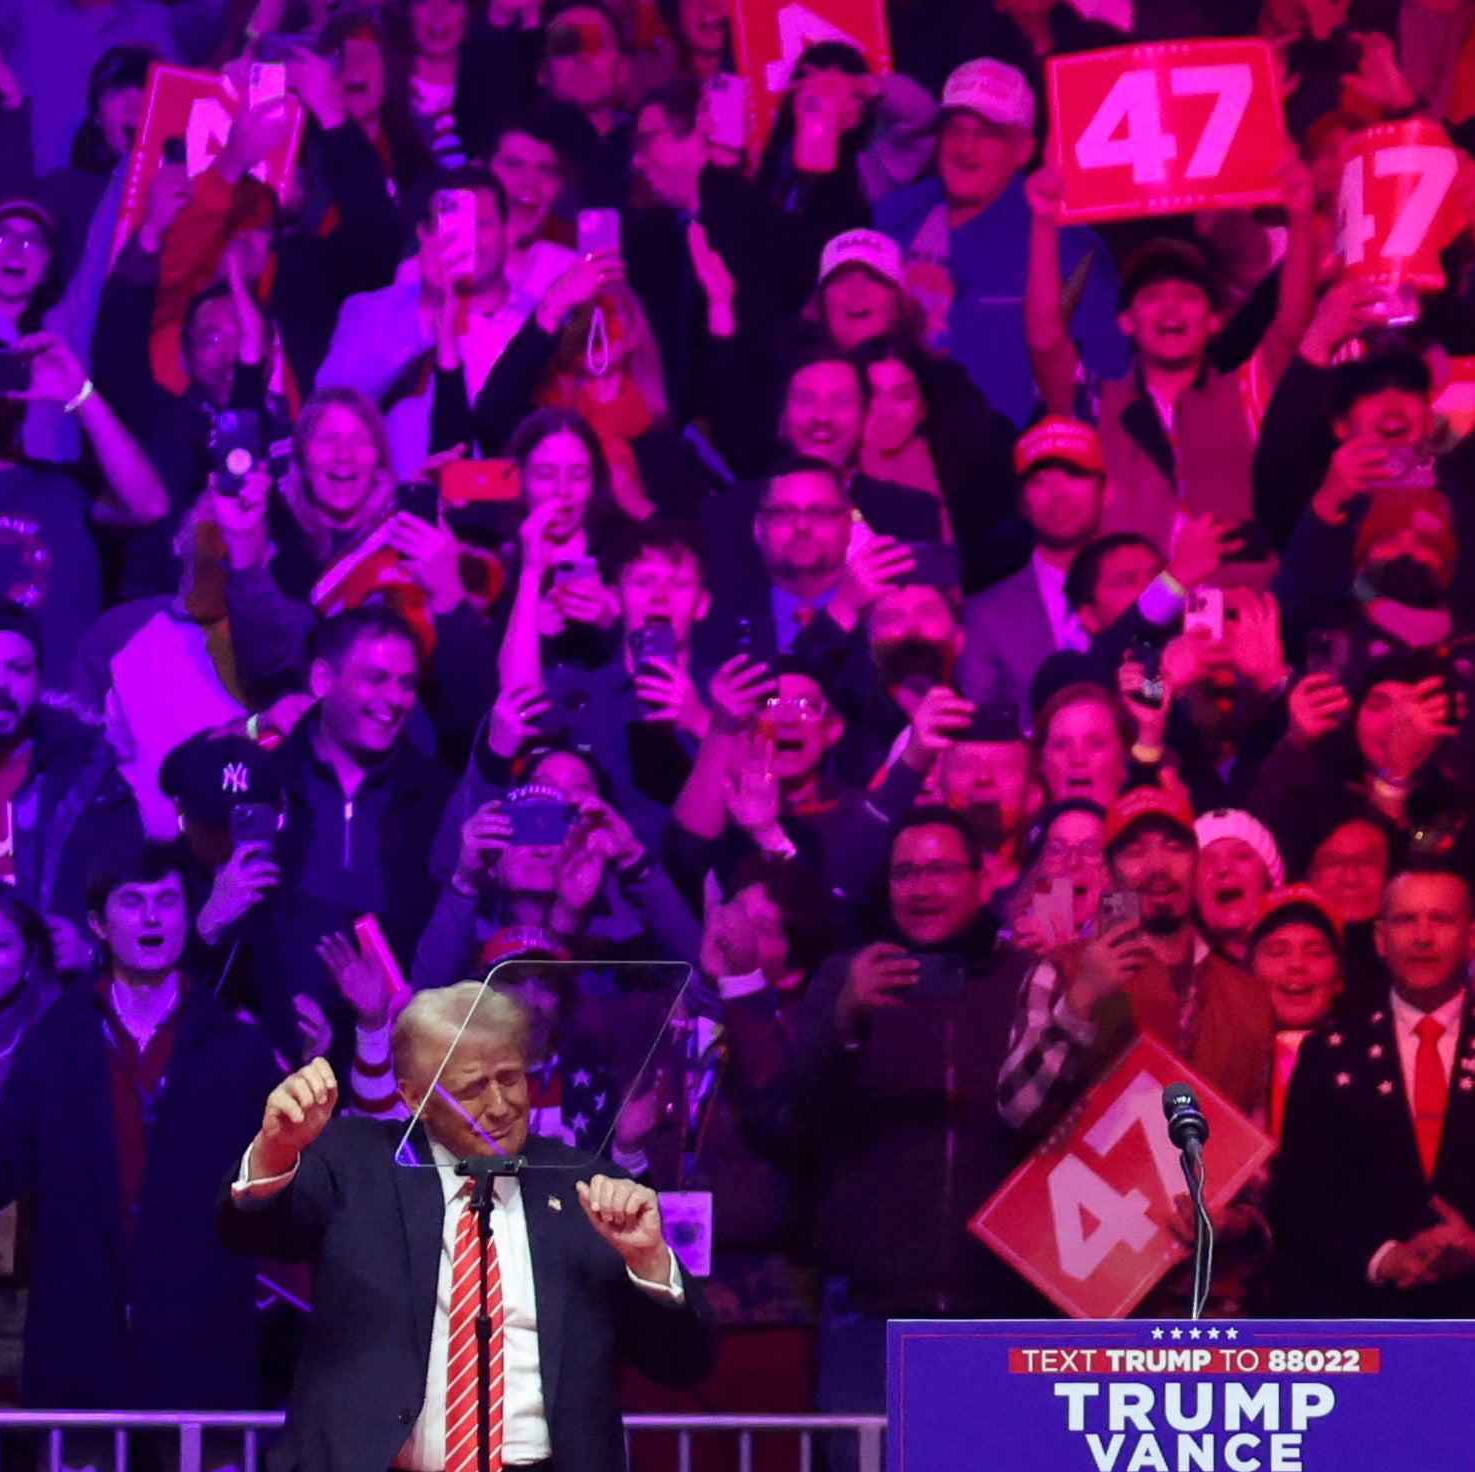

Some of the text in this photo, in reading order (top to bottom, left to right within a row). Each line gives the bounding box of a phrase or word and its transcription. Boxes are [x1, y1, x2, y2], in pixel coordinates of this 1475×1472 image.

[1075, 62, 1253, 185] 47
[1046, 1069, 1193, 1282] 47
[1022, 1350, 1360, 1372] TEXT TRUMP TO 88022
[1054, 1382, 1335, 1431] TRUMP
[1085, 1434, 1303, 1472] VANCE
